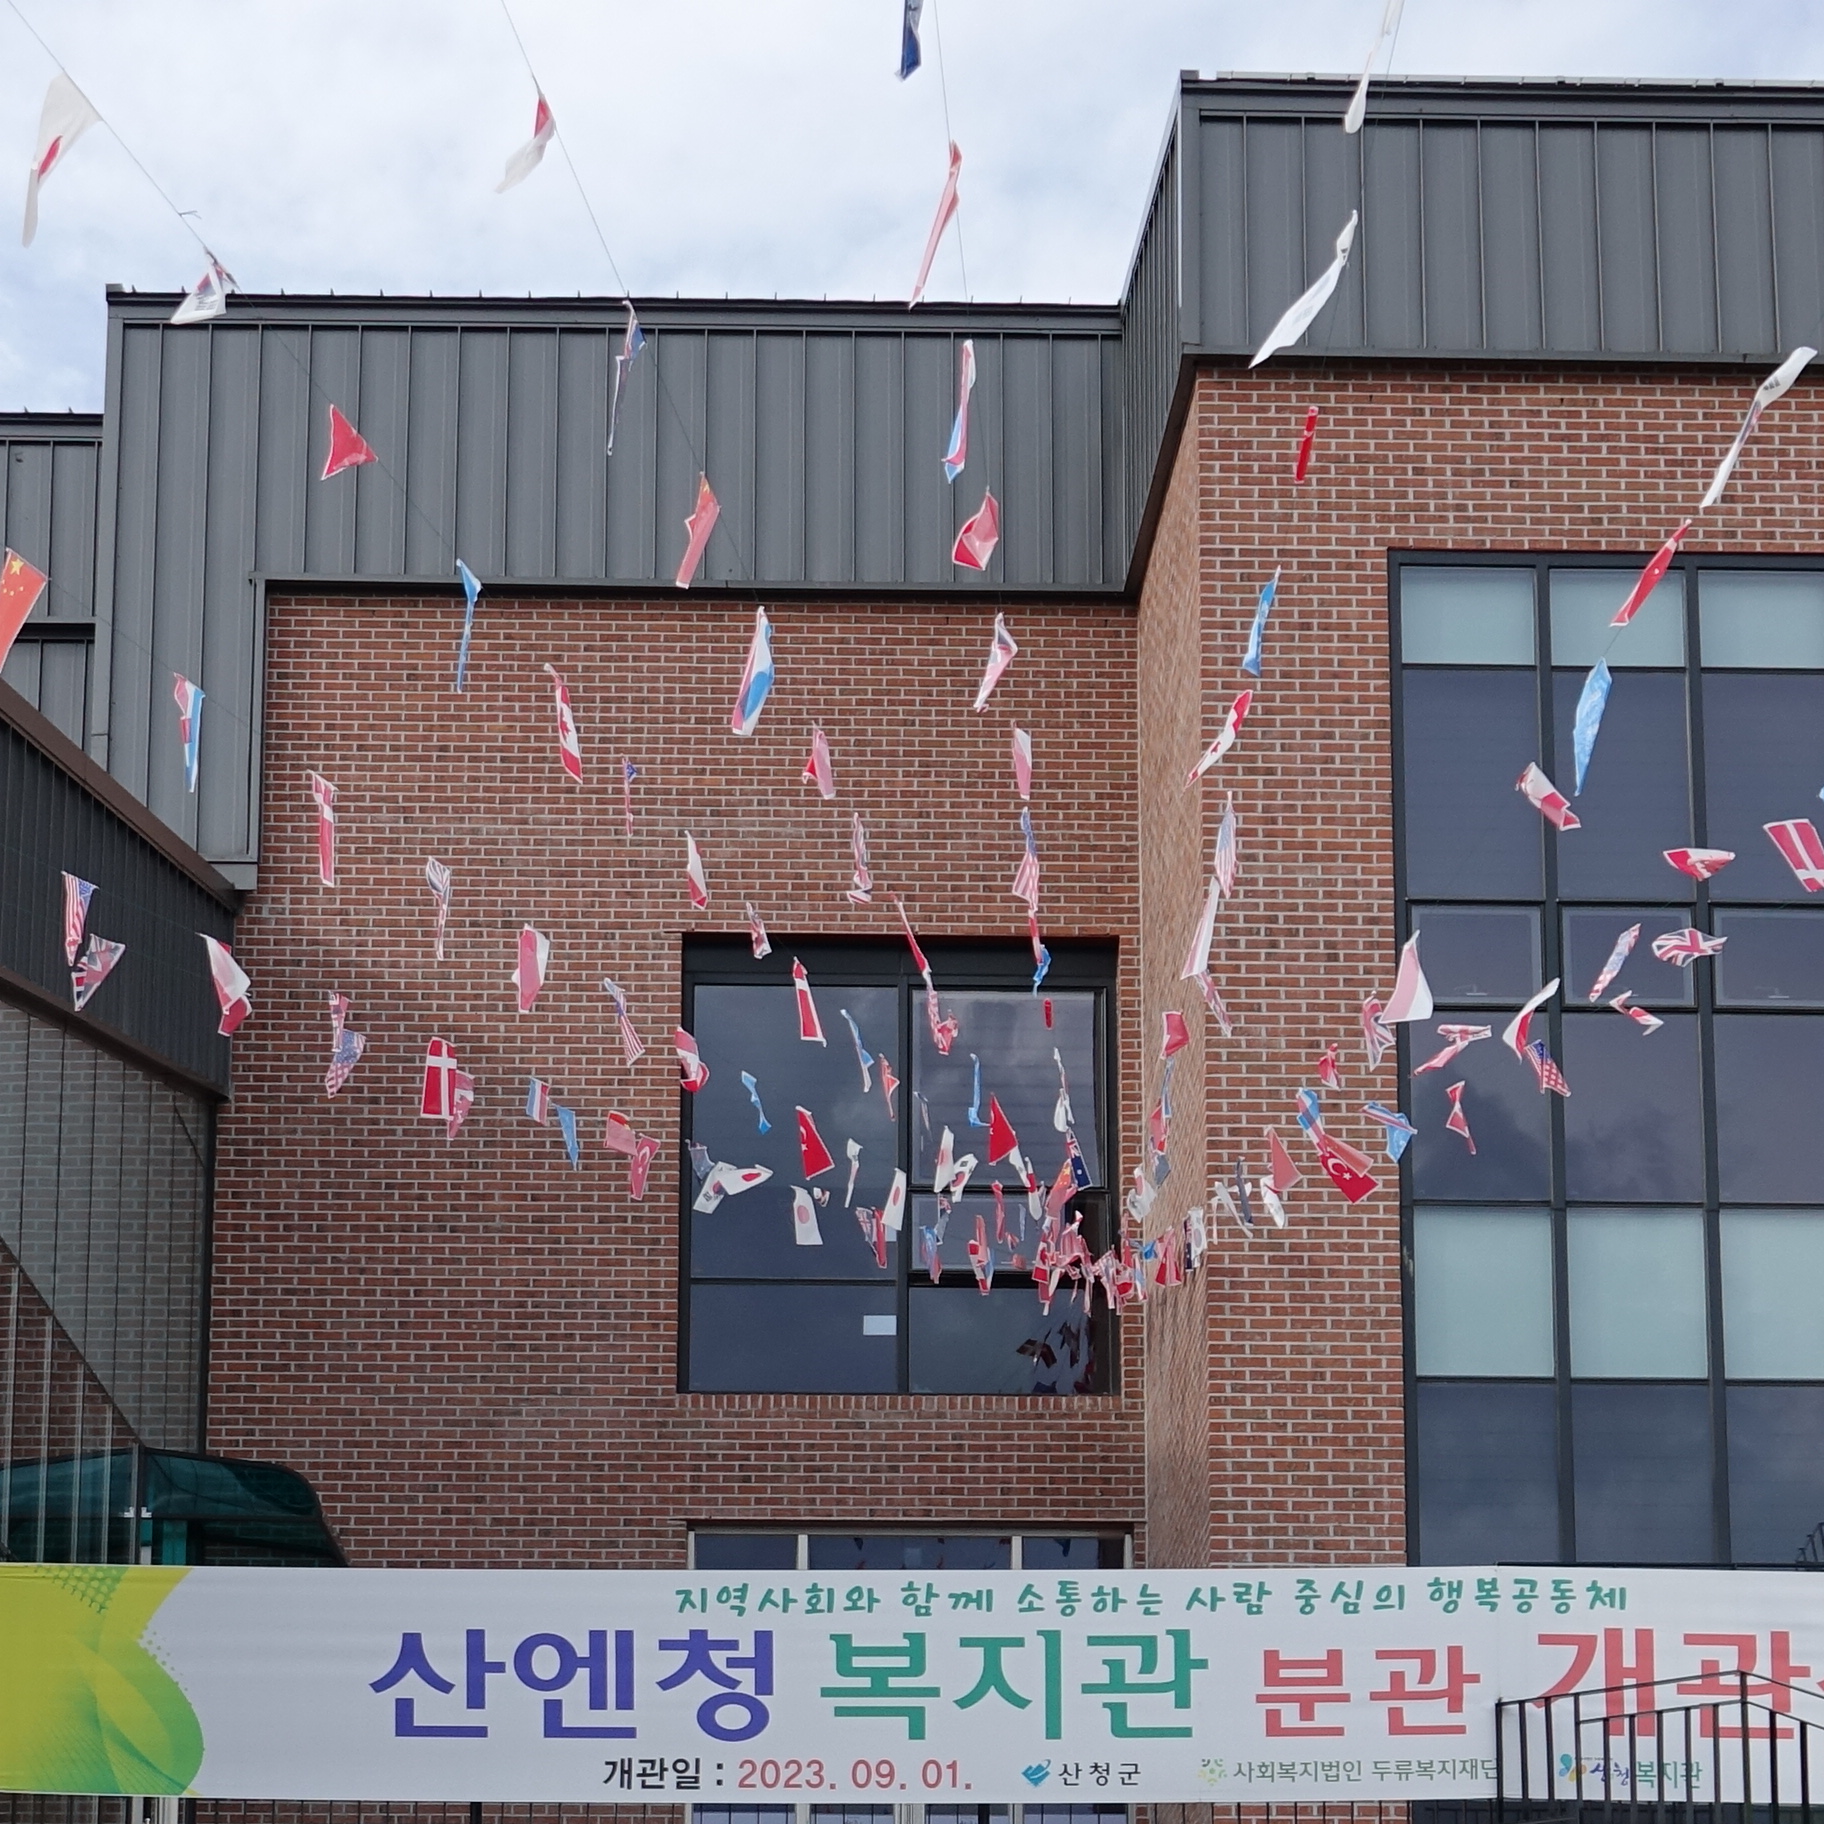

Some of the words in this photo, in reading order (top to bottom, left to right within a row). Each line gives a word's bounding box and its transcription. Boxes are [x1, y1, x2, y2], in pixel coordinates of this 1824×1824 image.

[676, 1582, 880, 1617] 지역사회와
[900, 1581, 994, 1617] 함께
[1017, 1580, 1163, 1617] 소통하는
[1185, 1581, 1272, 1615] 사람
[1294, 1578, 1406, 1615] 중심의
[1426, 1577, 1628, 1614] 행복공동체
[368, 1628, 774, 1743] 산엔청
[819, 1629, 1209, 1741] 복지관
[1255, 1645, 1481, 1738] 분관
[603, 1757, 702, 1791] 개관일
[737, 1759, 838, 1790] 2023.
[851, 1759, 907, 1790] 09.
[921, 1759, 973, 1790] 01.
[1057, 1760, 1142, 1787] 산청군
[1233, 1758, 1363, 1784] 사회복지법인
[1371, 1757, 1499, 1783] 두류복지재단
